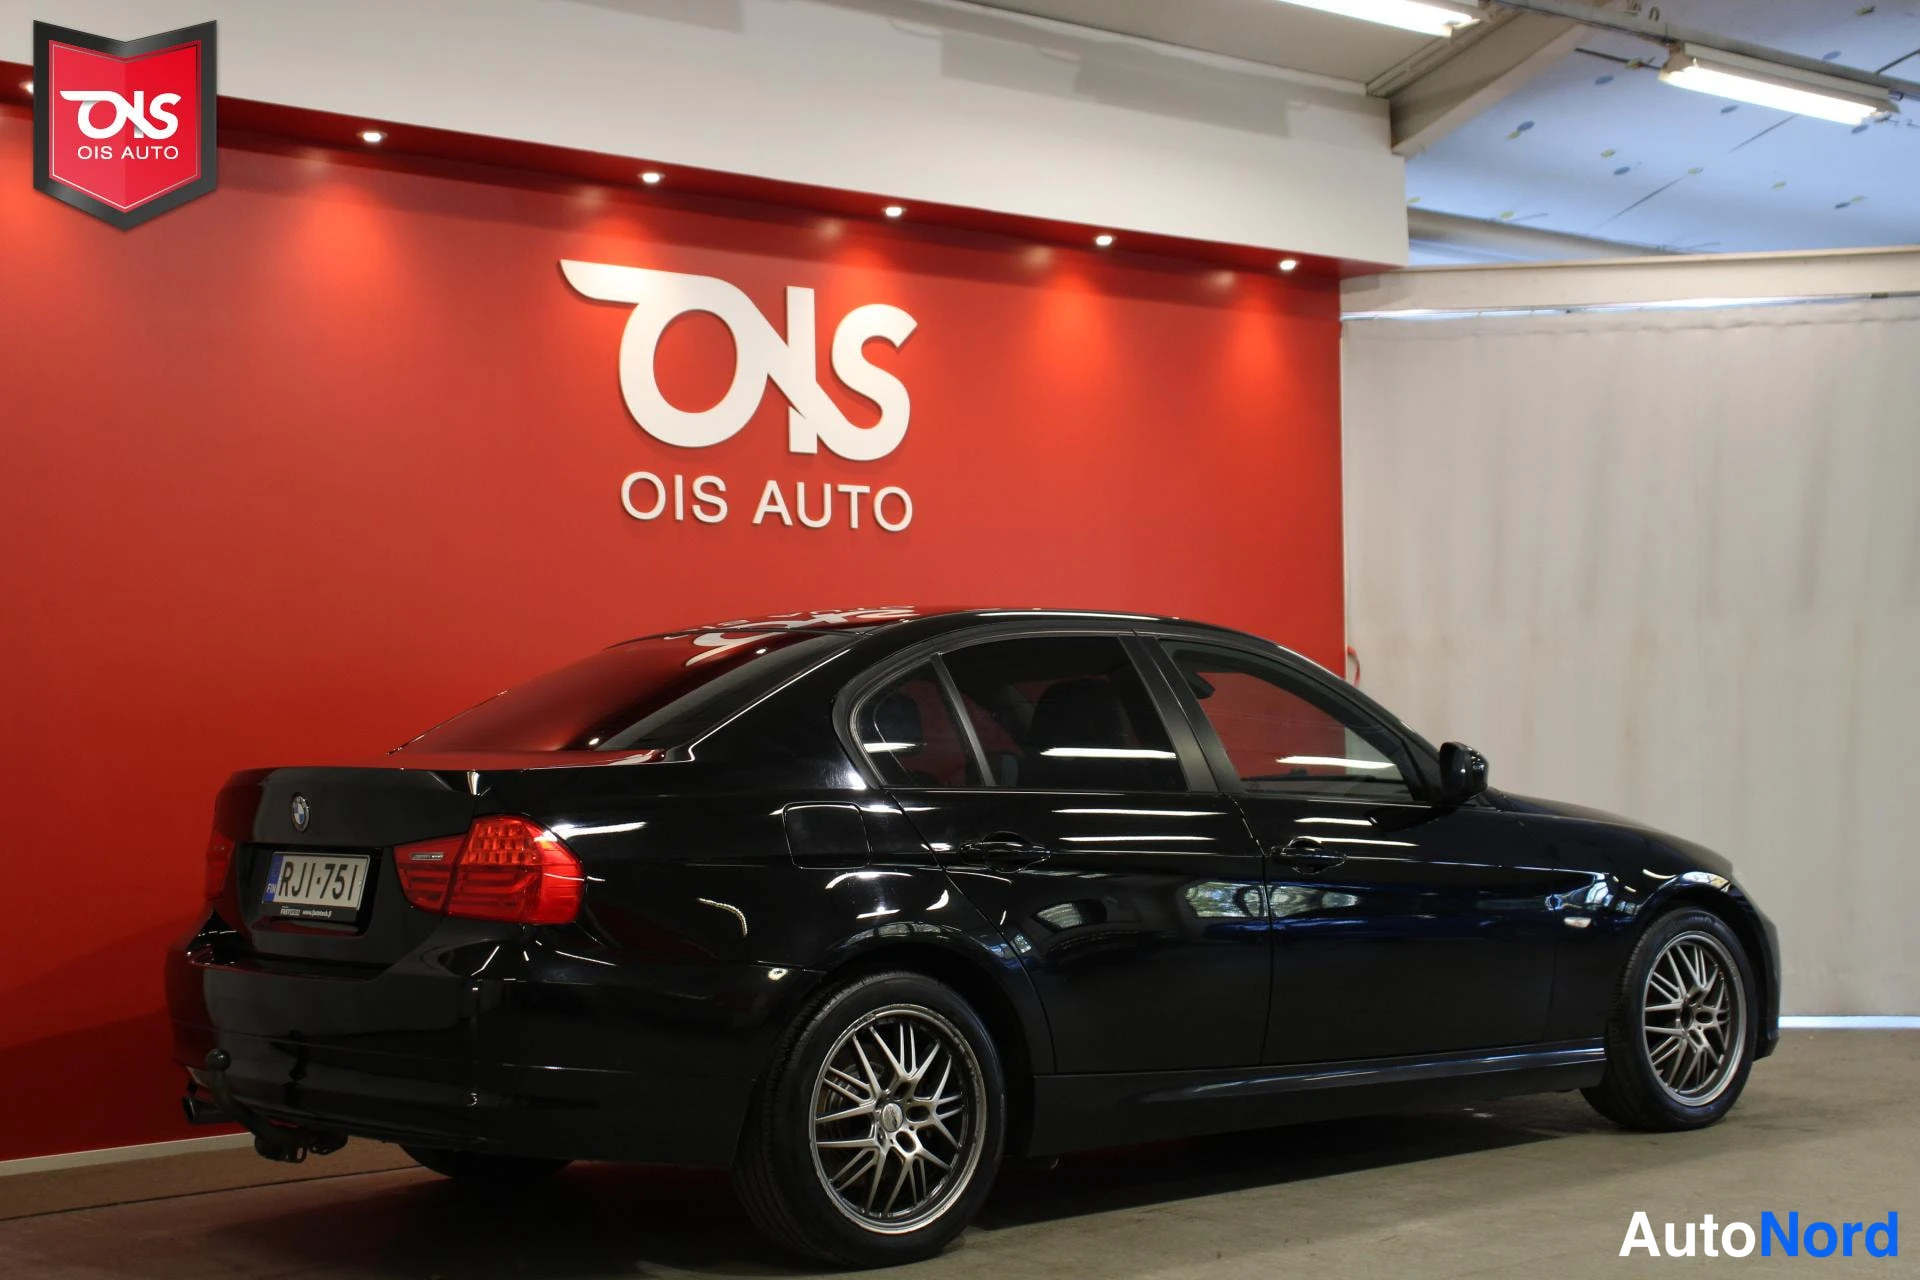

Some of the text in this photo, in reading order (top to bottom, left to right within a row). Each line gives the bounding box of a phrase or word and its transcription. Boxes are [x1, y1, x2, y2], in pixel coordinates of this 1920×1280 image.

[620, 470, 914, 532] OIS AUTO
[278, 861, 359, 901] RJI-751
